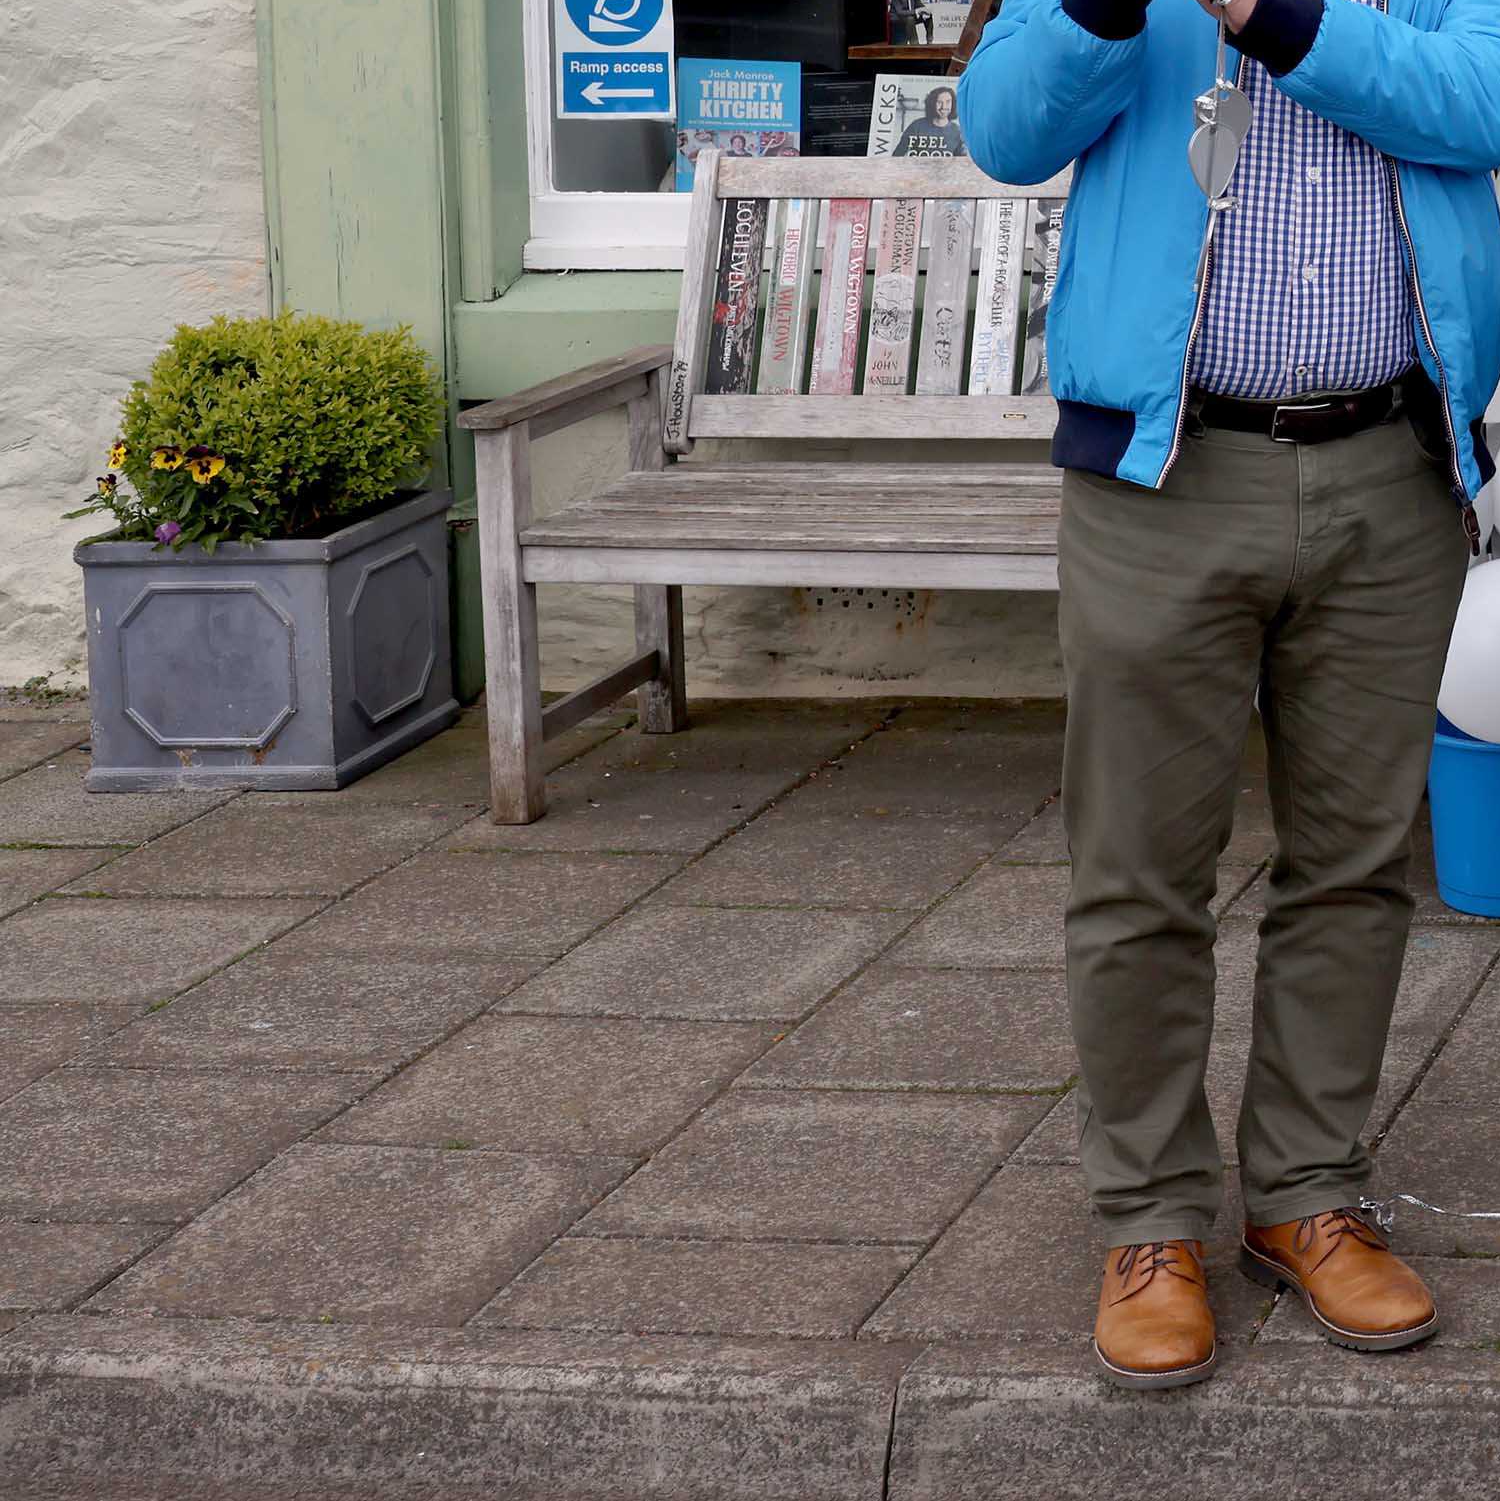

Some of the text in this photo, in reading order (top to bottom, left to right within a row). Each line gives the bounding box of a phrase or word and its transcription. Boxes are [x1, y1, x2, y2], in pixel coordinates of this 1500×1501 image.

[570, 61, 664, 76] Ramp access
[708, 69, 731, 79] Jack
[699, 79, 783, 100] THRIFTY
[700, 100, 784, 120] KITCHEN
[874, 83, 897, 156] WICKS
[908, 135, 947, 149] FEEL
[1000, 200, 1014, 216] THE
[1049, 205, 1064, 229] THE
[781, 227, 800, 284] HISTORIC
[844, 255, 864, 335] WIGTOWN
[772, 287, 795, 362] WIGTOWN
[872, 360, 898, 371] JOHN
